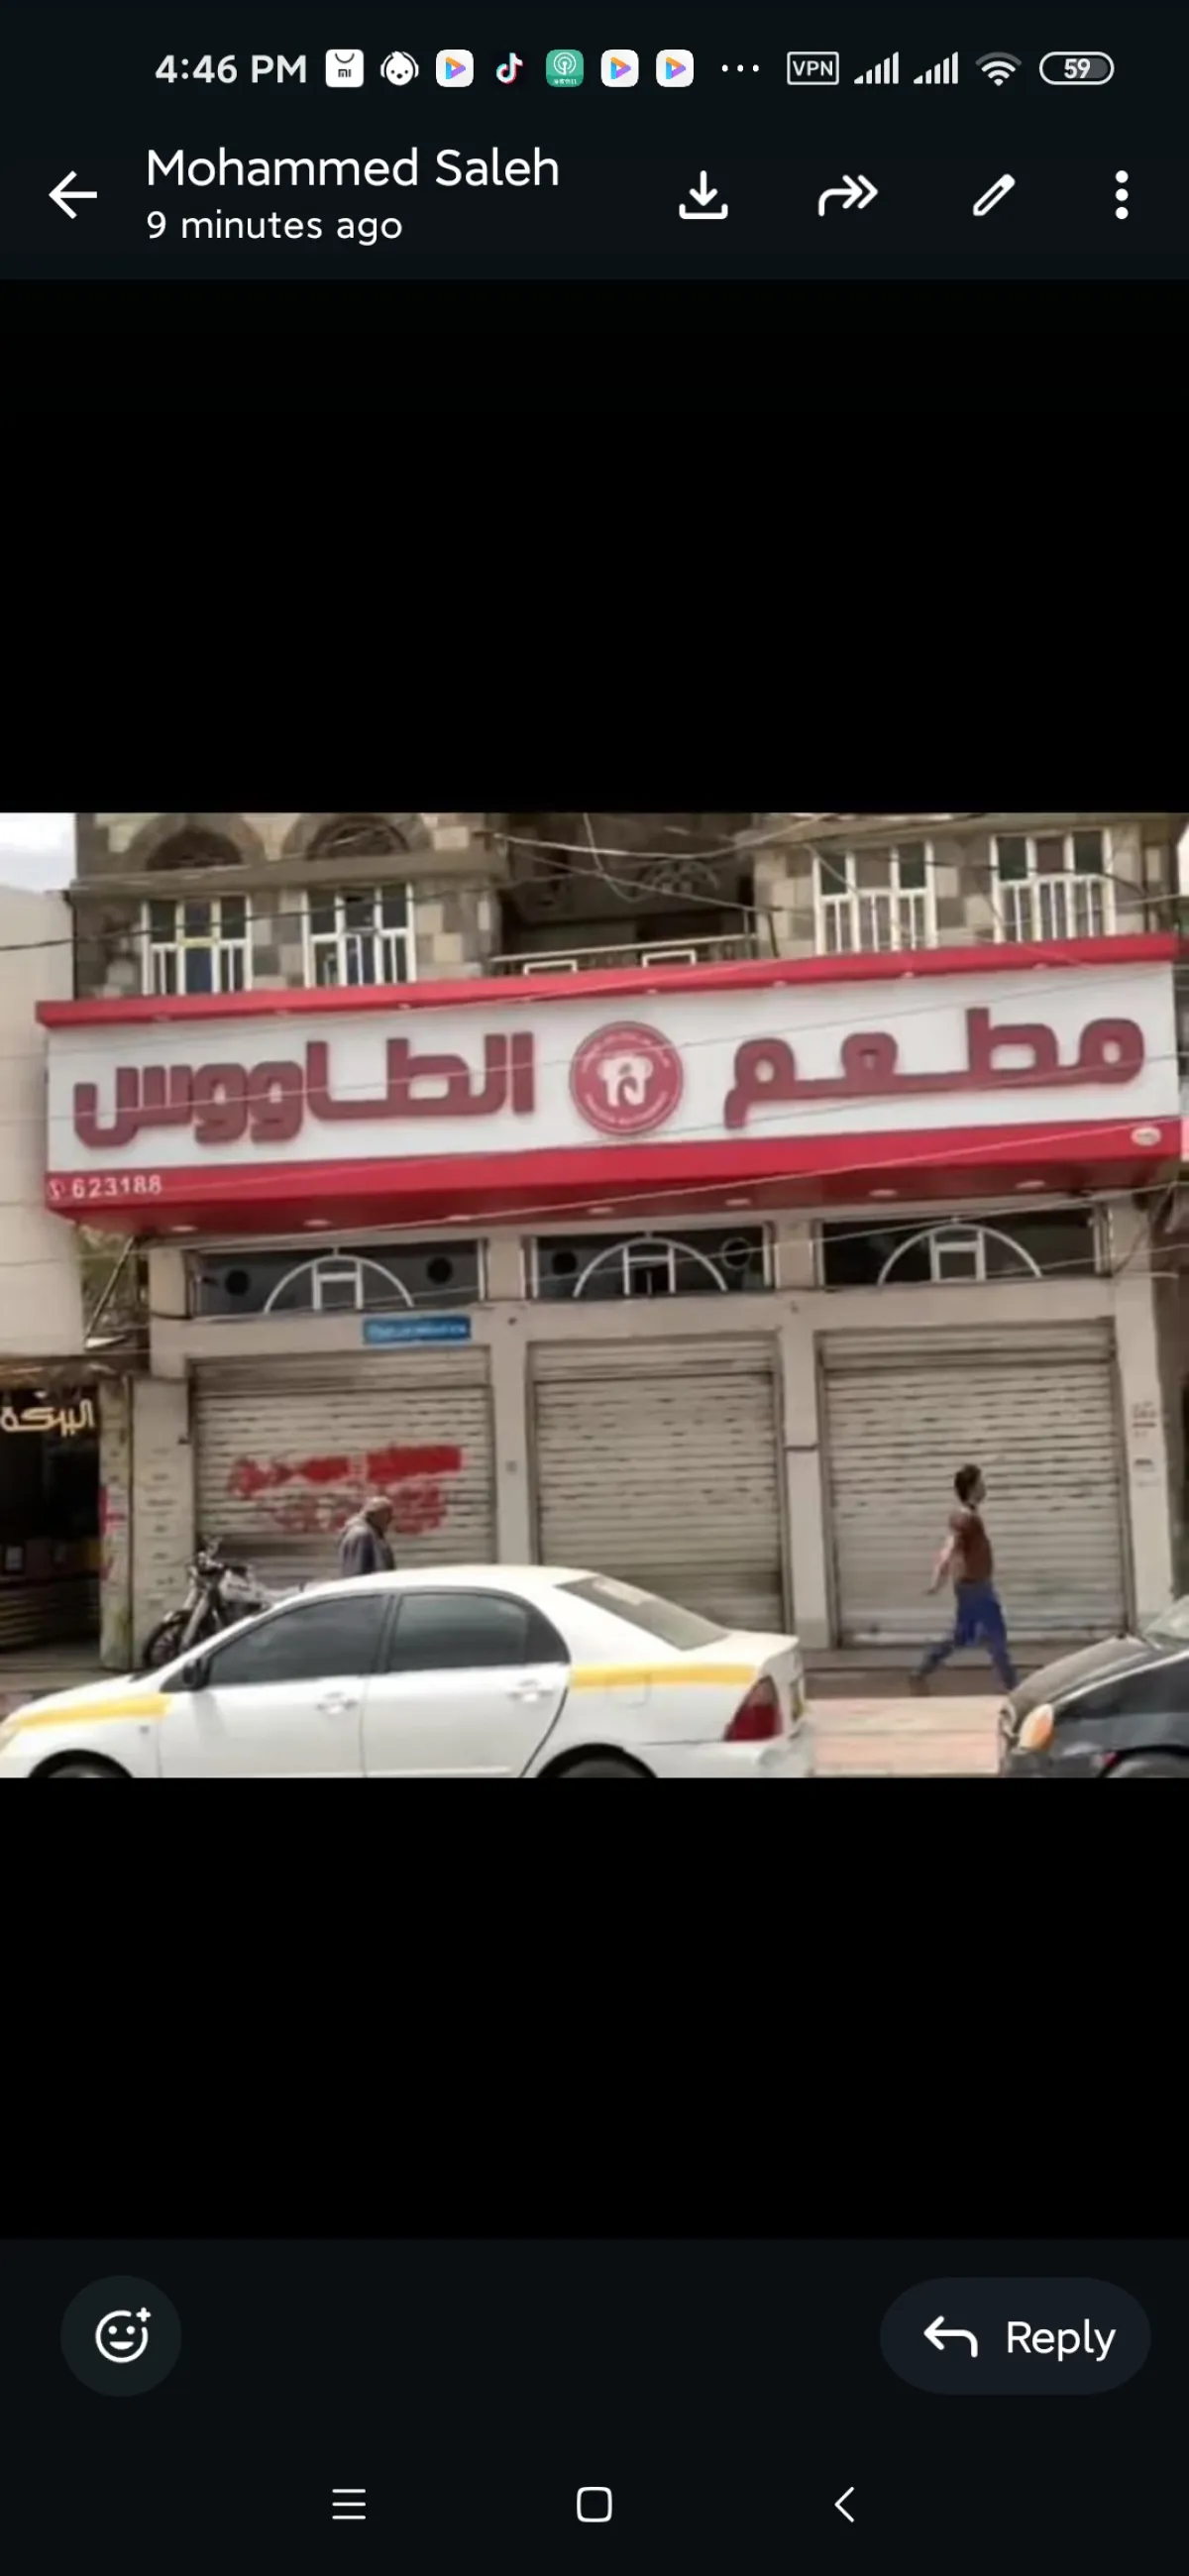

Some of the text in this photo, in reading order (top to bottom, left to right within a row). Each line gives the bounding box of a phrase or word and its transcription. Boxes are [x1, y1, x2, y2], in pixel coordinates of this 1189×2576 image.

[73, 1006, 1146, 1148] مطعم الطاووس
[71, 1174, 162, 1200] 623188
